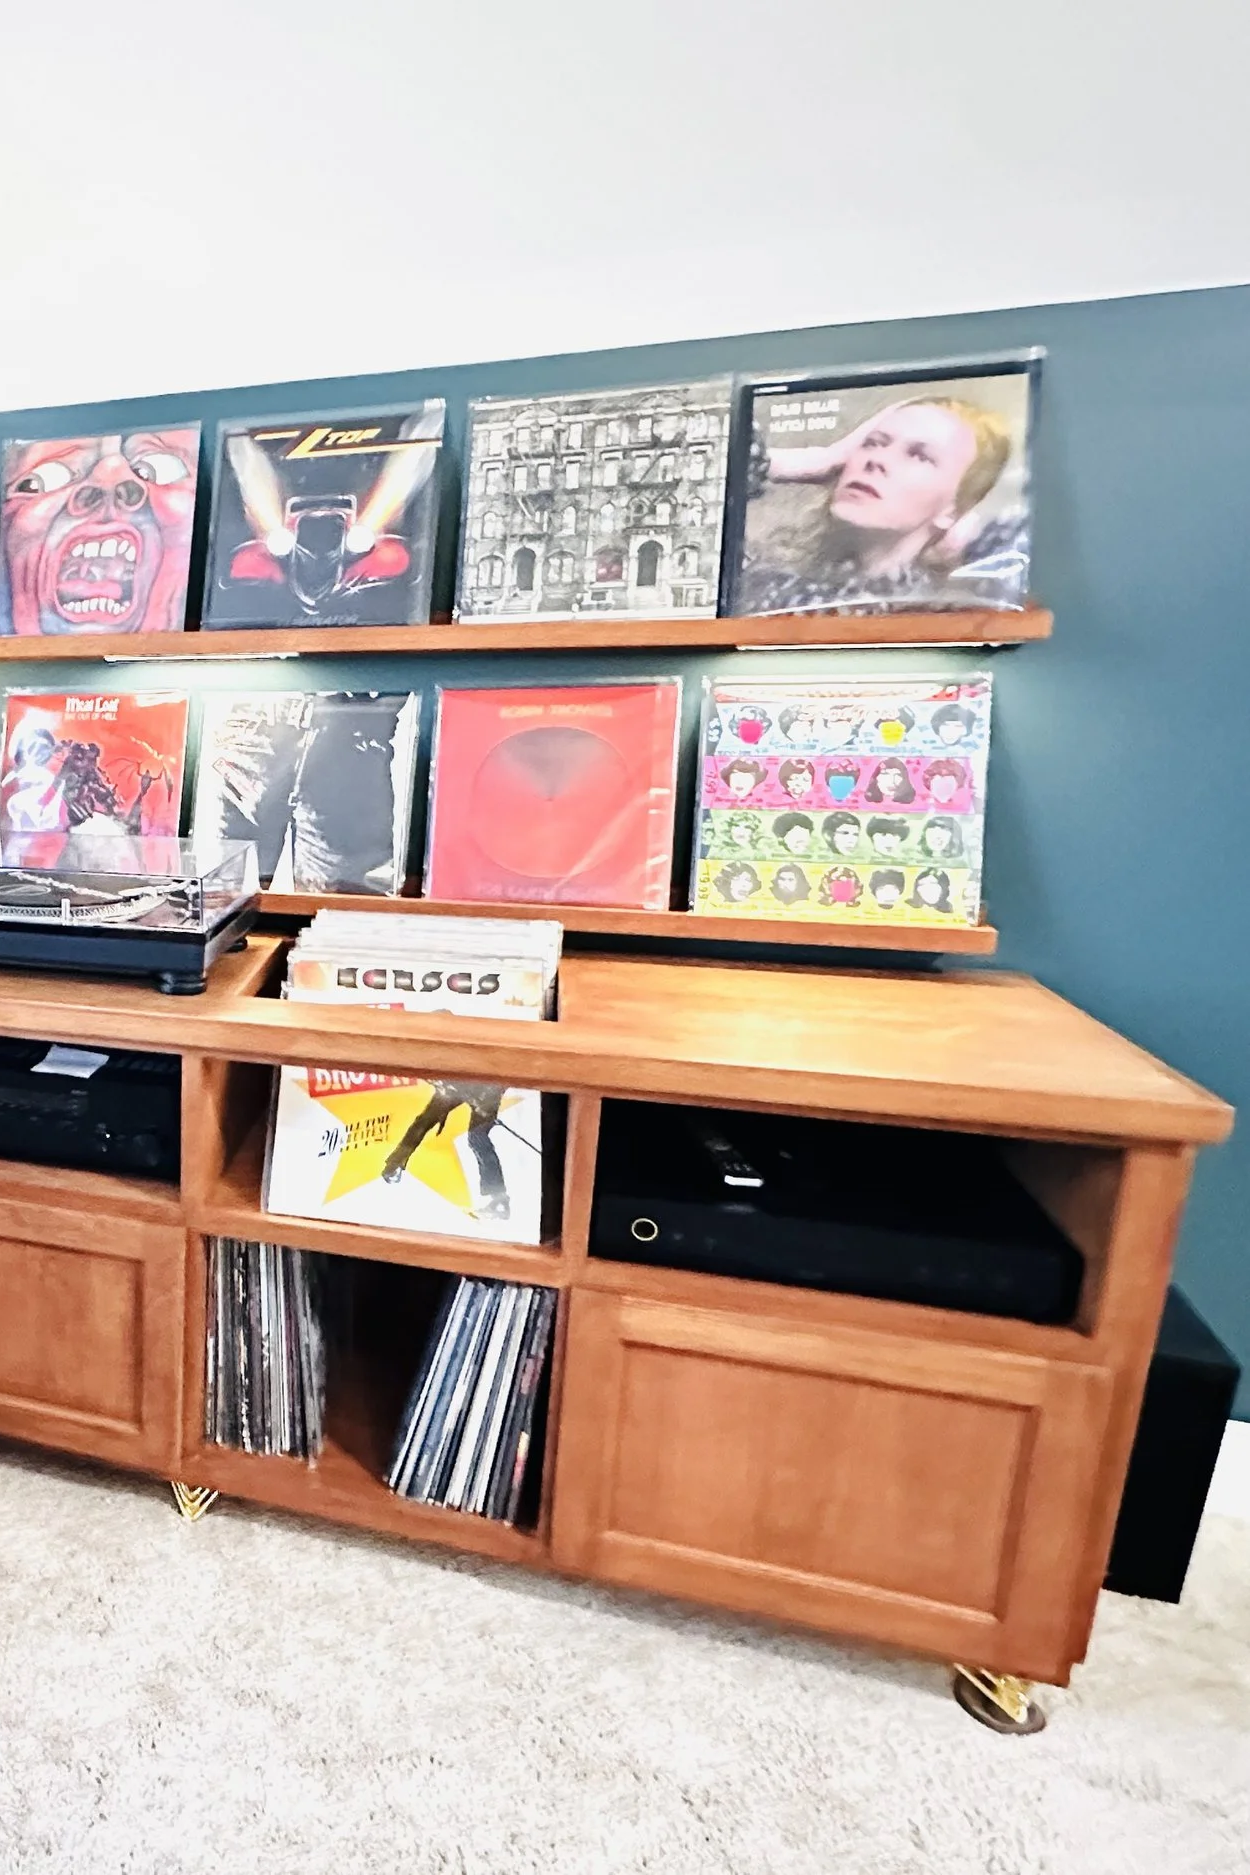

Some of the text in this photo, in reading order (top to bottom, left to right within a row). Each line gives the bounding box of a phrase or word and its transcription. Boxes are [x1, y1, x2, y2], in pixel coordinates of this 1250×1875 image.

[322, 427, 383, 446] TOP
[314, 1066, 411, 1093] BRO
[317, 1127, 339, 1158] 20
